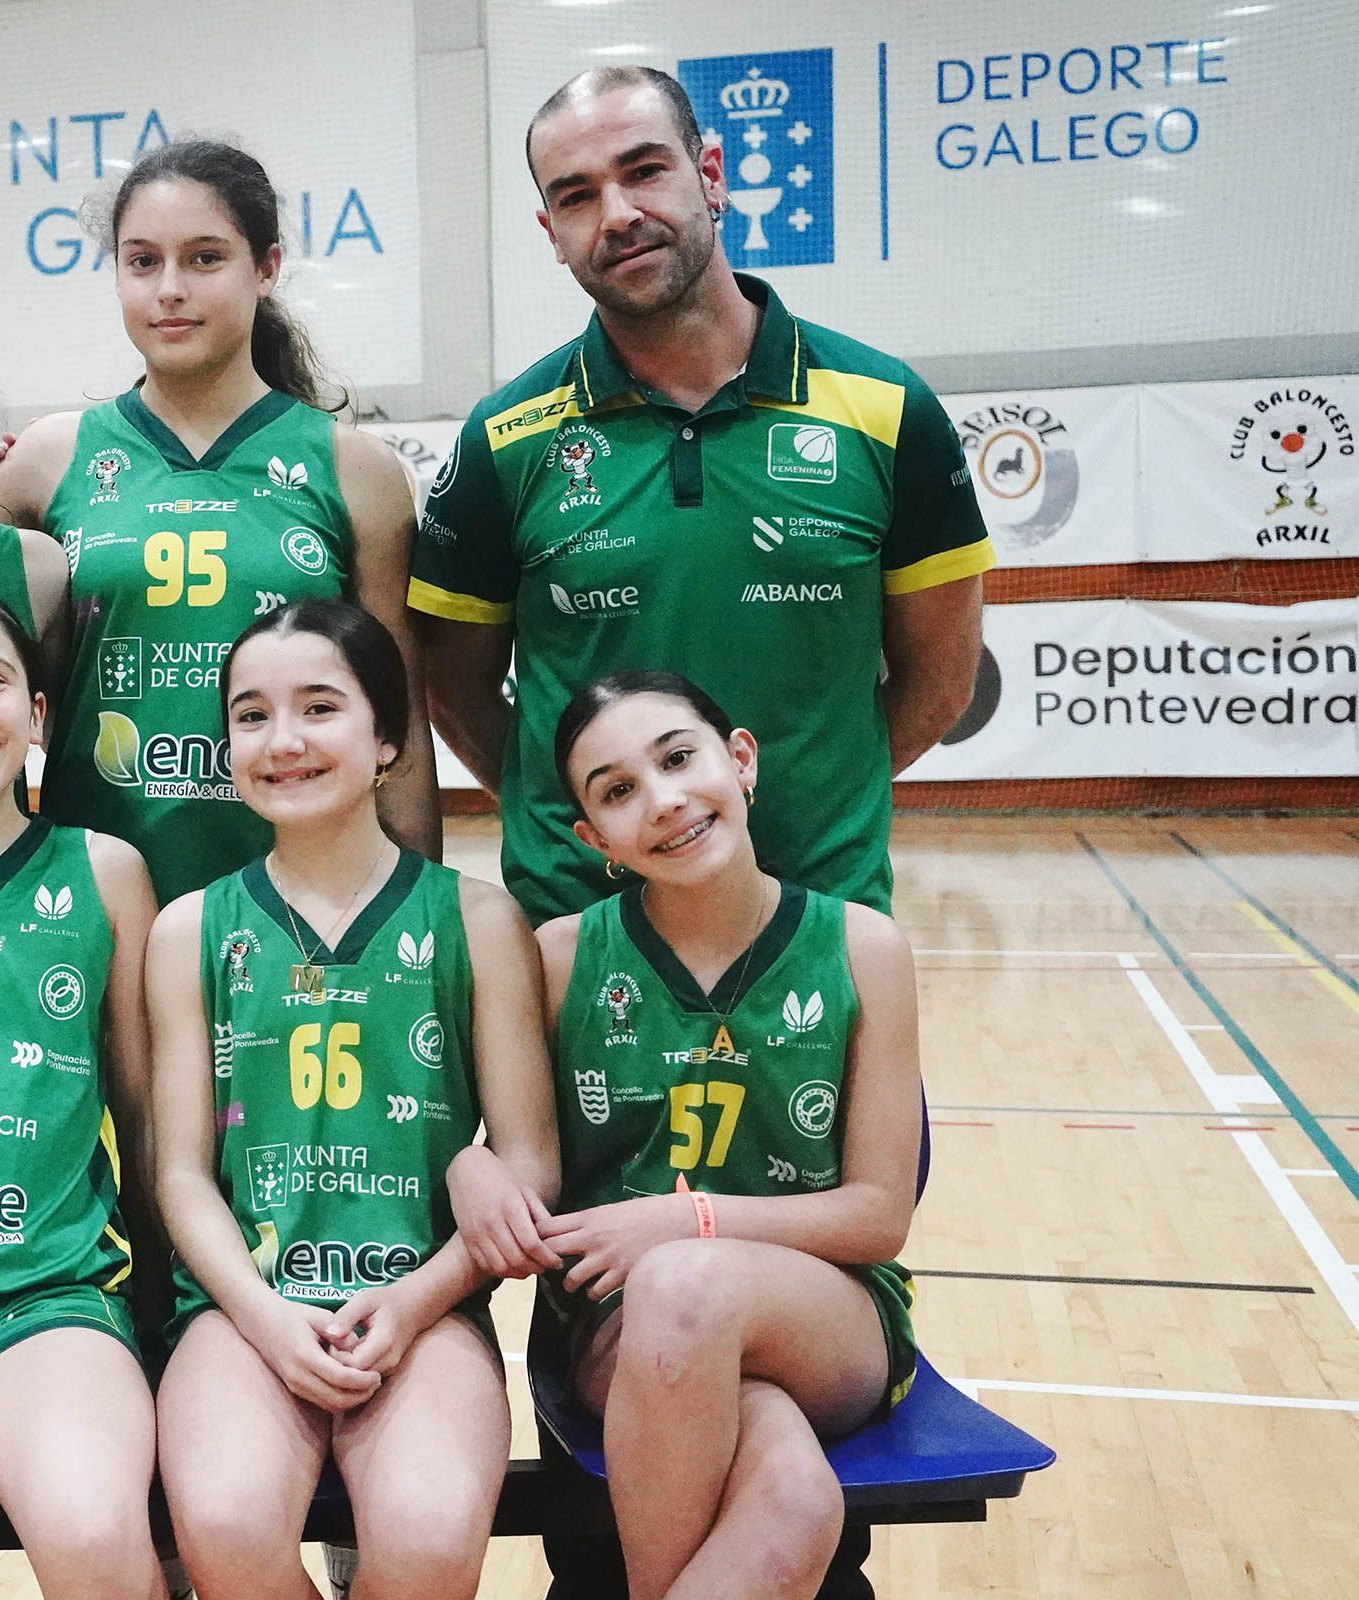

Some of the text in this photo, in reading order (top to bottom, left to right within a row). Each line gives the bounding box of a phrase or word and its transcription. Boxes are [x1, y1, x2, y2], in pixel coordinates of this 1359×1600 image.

[937, 38, 1228, 105] DEPORTE
[936, 107, 1200, 170] GALEGO
[1230, 388, 1355, 460] CLUB BALONCESTO
[546, 424, 611, 468] CLUB BALONCESTO
[89, 493, 121, 506] ARXIL
[253, 487, 271, 497] LF
[559, 494, 602, 513] ARXIL
[789, 517, 845, 529] DEPORTE
[789, 528, 841, 538] GALEGO
[567, 528, 609, 544] XUNTA
[568, 535, 636, 554] DE GALICIA
[1256, 524, 1331, 547] ARXIL
[144, 530, 227, 608] 95
[573, 585, 639, 611] ence
[1033, 632, 1357, 688] Deputación
[150, 668, 180, 688] DE
[1036, 688, 1358, 727] Pontevedra
[143, 733, 232, 780] enc
[146, 782, 197, 797] ENERGÍA
[200, 785, 212, 797] &
[20, 923, 38, 933] LF
[385, 972, 402, 984] LF
[604, 1034, 638, 1048] ARXIL
[766, 1035, 786, 1047] LF
[289, 1022, 363, 1111] 66
[669, 1080, 746, 1170] 57
[293, 1145, 367, 1168] XUNTA
[291, 1171, 419, 1198] DE GALICIA
[281, 1240, 420, 1285] ence
[284, 1284, 341, 1298] ENERGÍA
